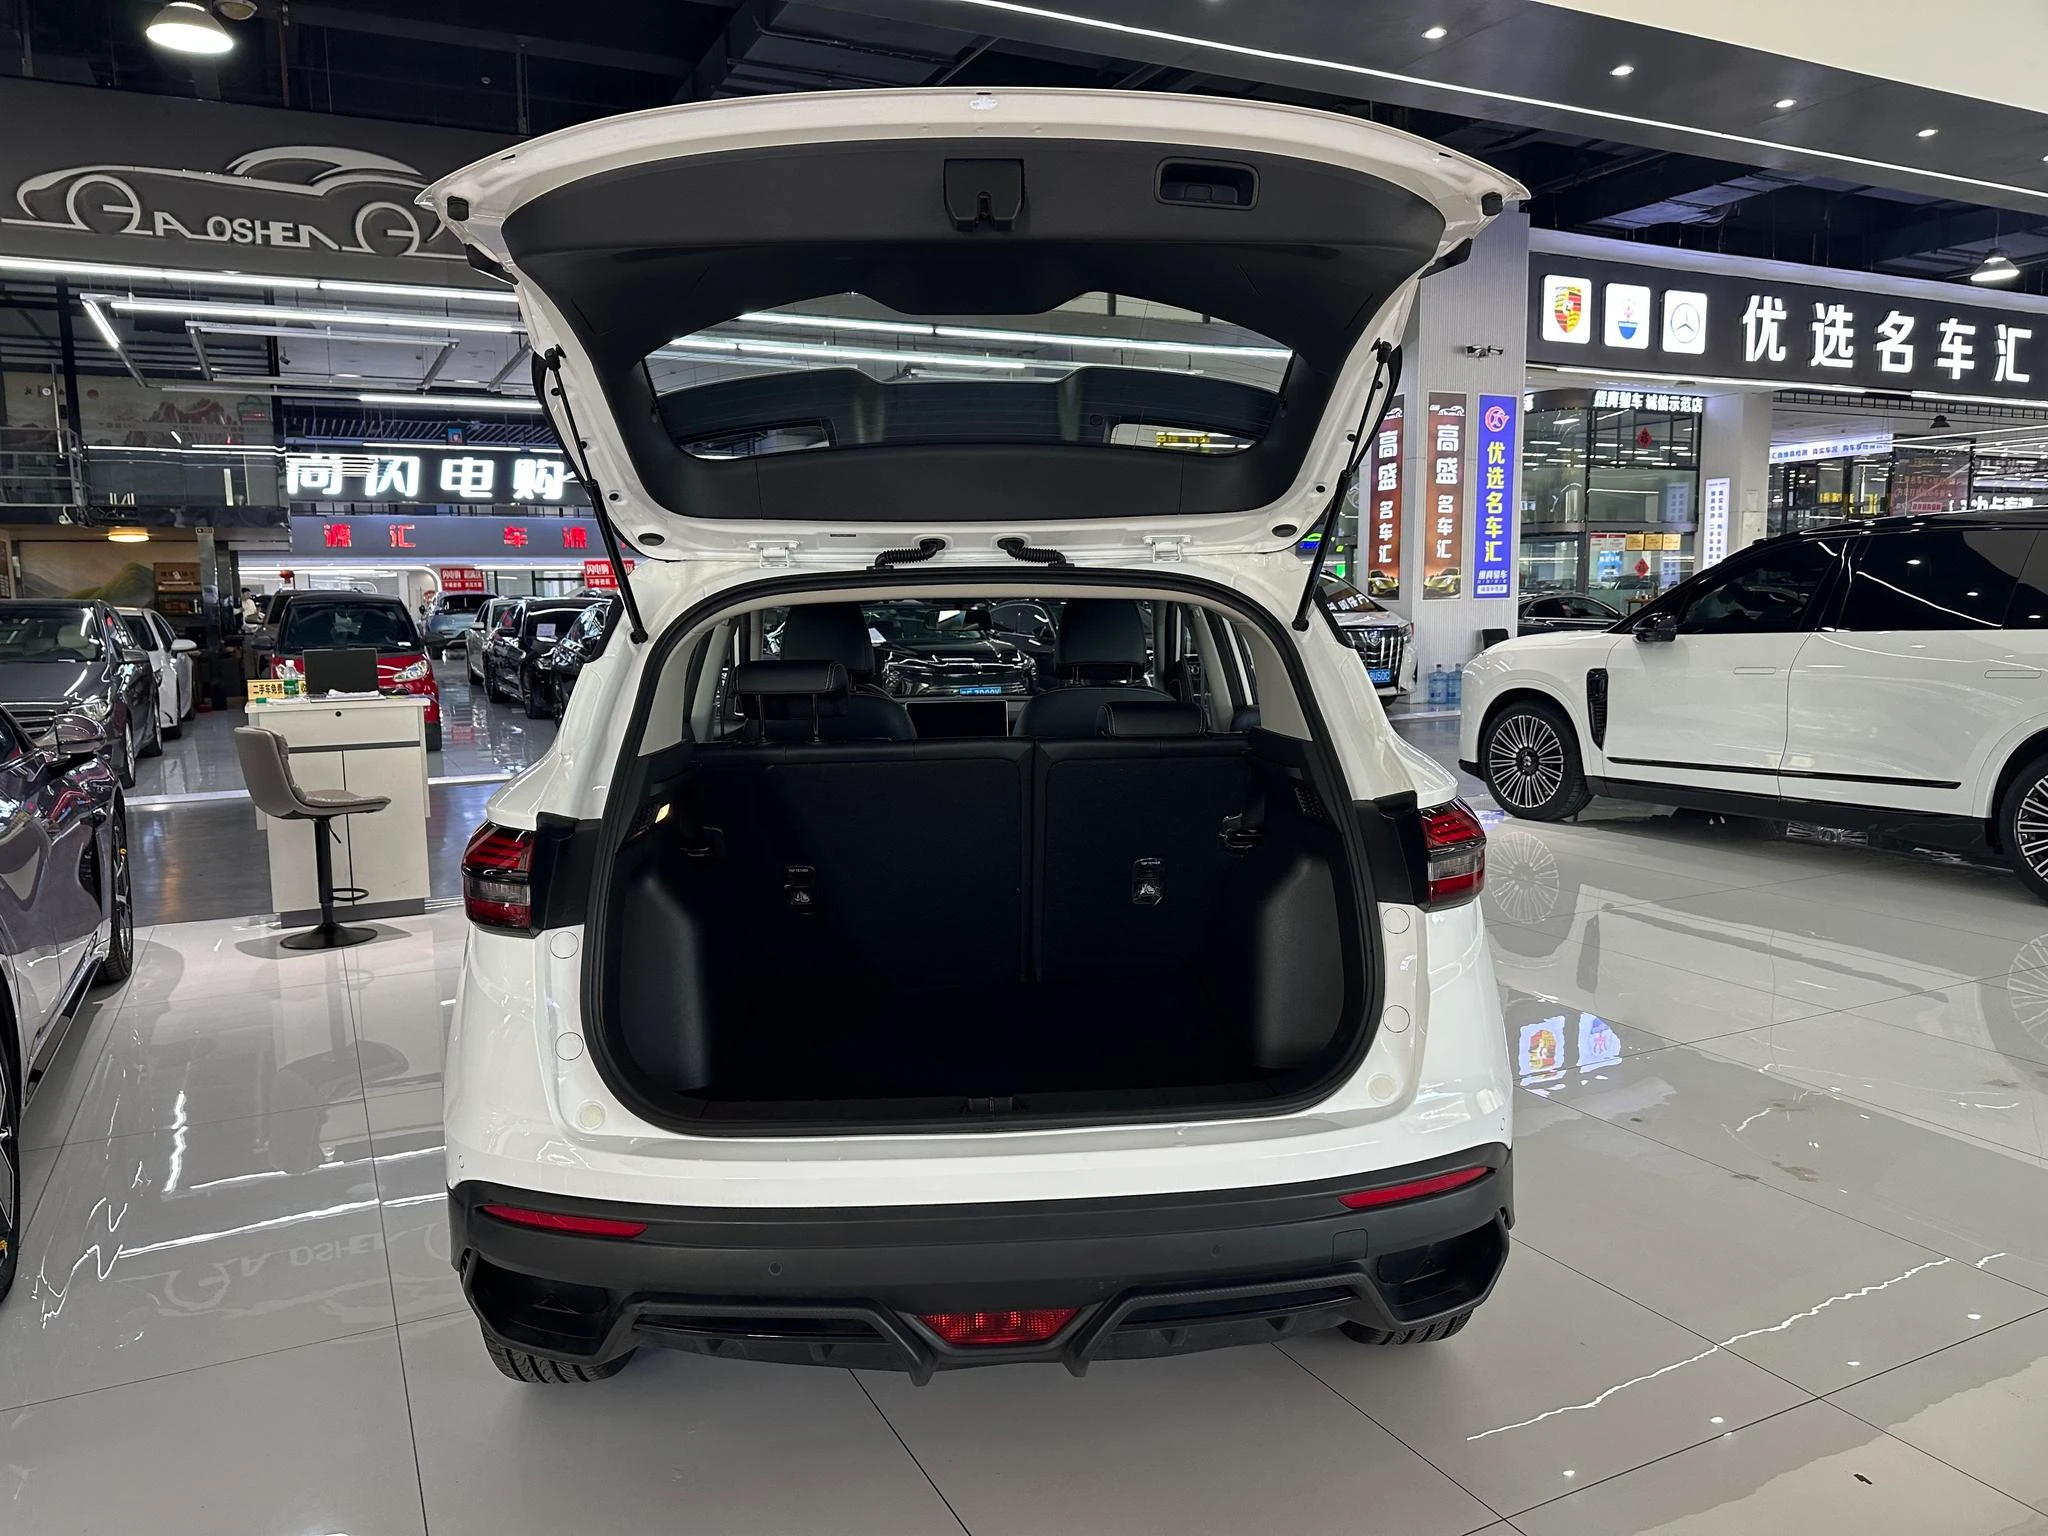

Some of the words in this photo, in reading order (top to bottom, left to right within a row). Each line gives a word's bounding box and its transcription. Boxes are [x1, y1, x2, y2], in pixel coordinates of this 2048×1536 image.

[1742, 294, 2033, 383] 优选名车汇
[1485, 441, 1506, 563] 优选名车汇
